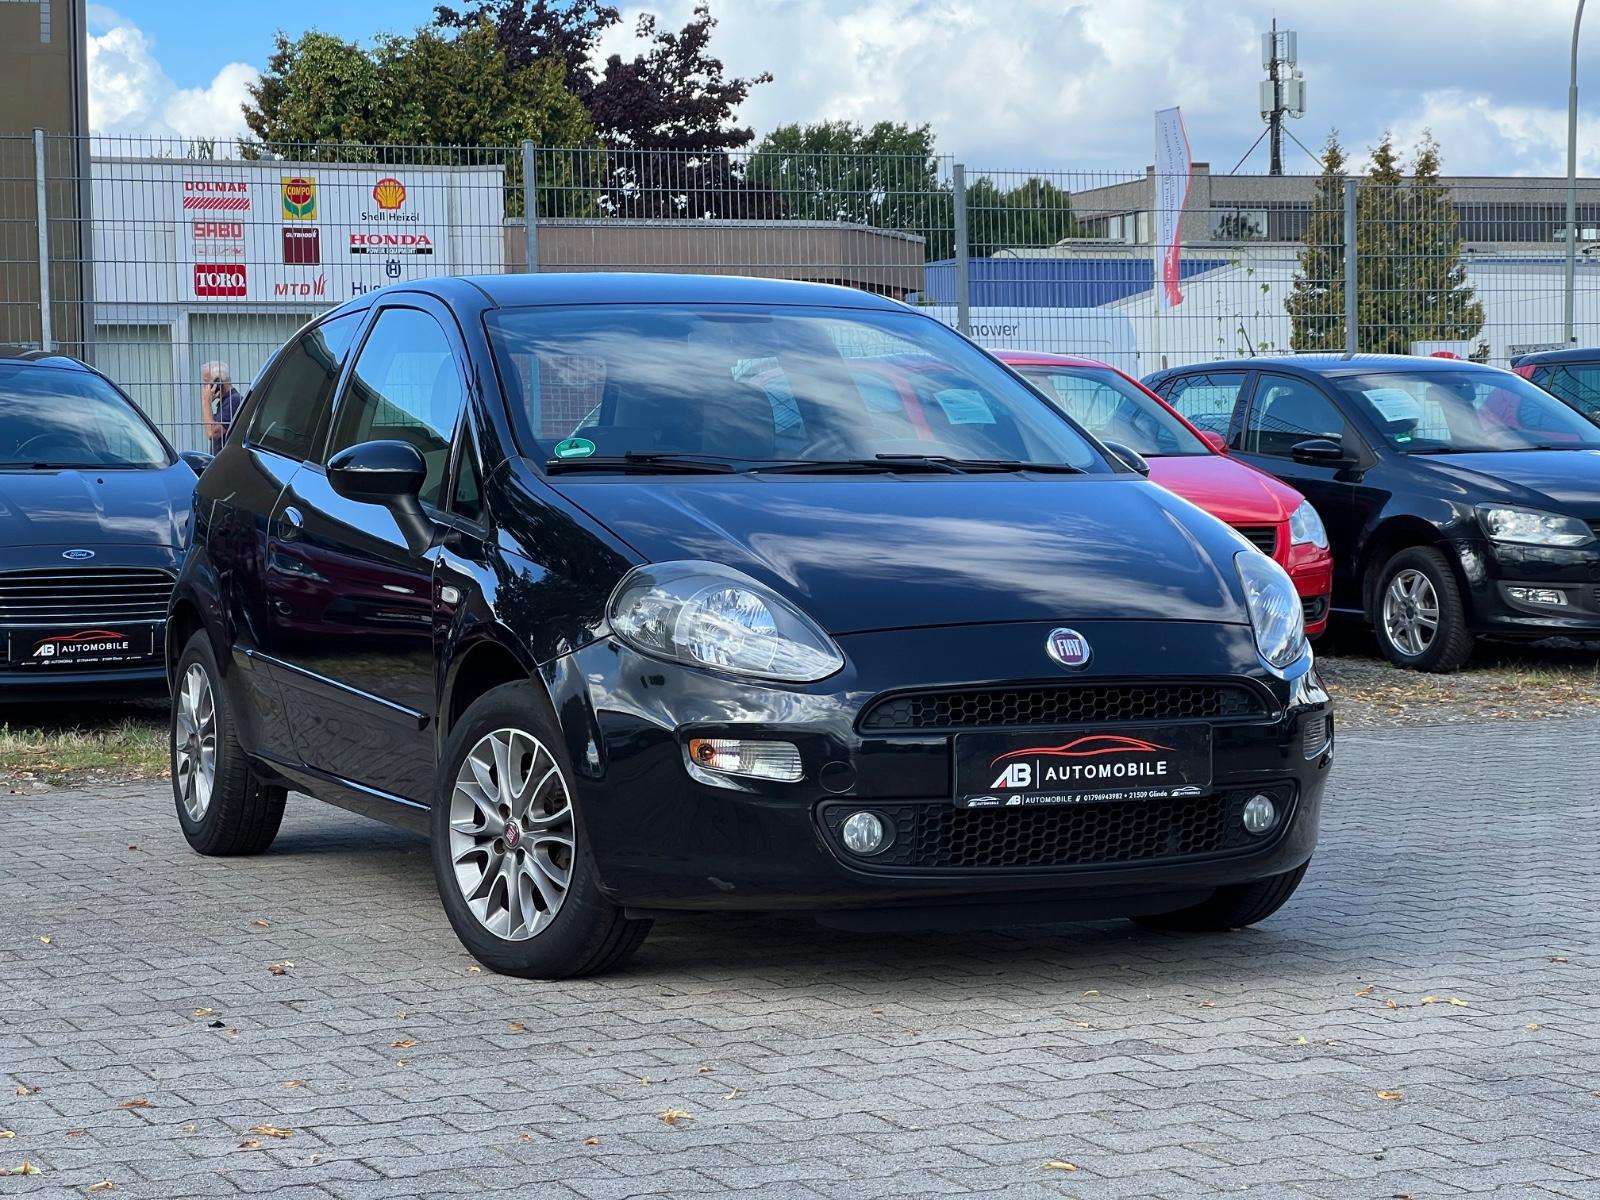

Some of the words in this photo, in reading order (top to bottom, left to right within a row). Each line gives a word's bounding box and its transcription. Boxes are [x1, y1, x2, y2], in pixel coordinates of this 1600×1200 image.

[185, 181, 247, 192] DOLMAR
[287, 186, 311, 196] COMPO
[361, 211, 385, 221] Shell
[388, 212, 420, 222] Heizöl
[194, 221, 242, 238] SABO
[349, 234, 432, 245] HONDA
[196, 272, 245, 288] TORO
[274, 283, 311, 296] MTD
[32, 643, 55, 657] AB
[61, 641, 129, 653] AUTOMOBILE
[1056, 639, 1082, 656] FIAT
[989, 762, 1032, 789] AB
[1045, 760, 1167, 781] AUTOMOBILE
[1005, 795, 1021, 806] AB
[1025, 795, 1072, 804] AUTOMOBILE
[1129, 791, 1147, 799] 21509
[1148, 790, 1168, 798] Glinde
